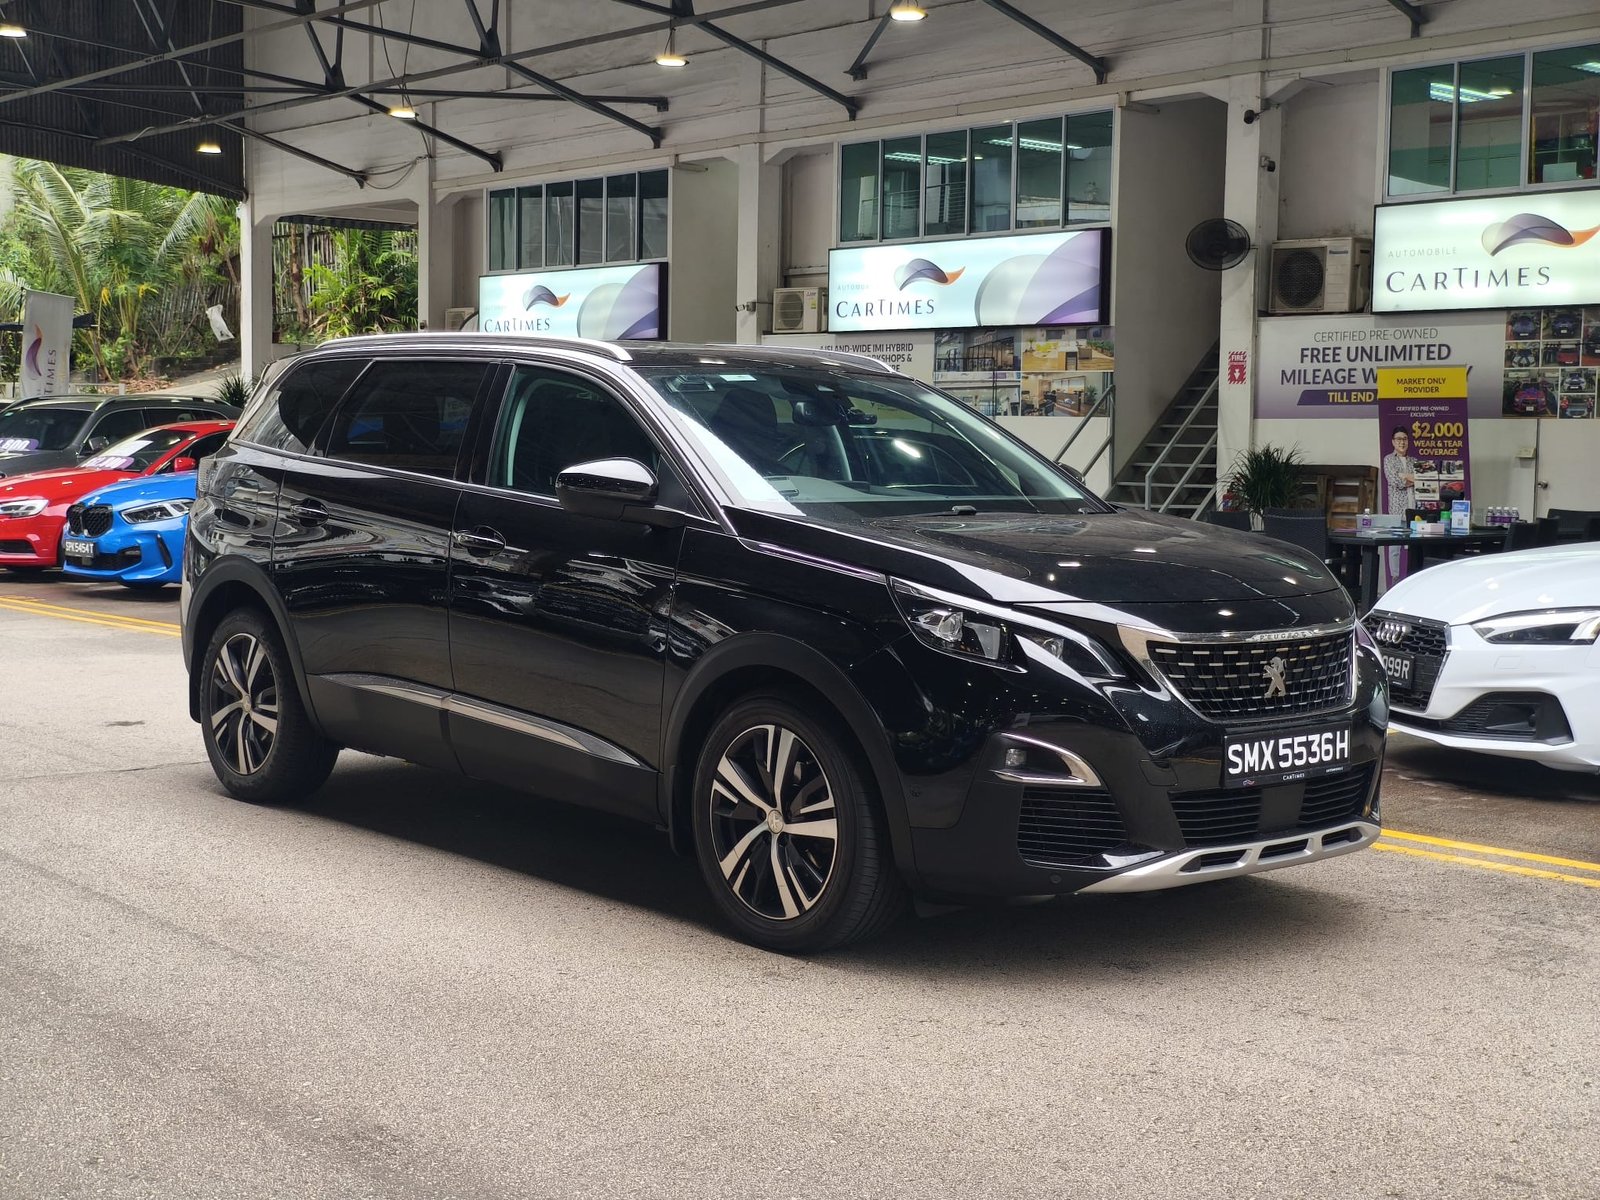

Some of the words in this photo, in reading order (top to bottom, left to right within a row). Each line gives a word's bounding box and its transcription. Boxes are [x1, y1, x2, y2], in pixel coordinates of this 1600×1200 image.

[1388, 247, 1457, 258] AUTOMOBILE
[1314, 330, 1367, 343] CERTIFIED
[1369, 328, 1438, 341] PRE-OWNED
[886, 343, 914, 351] HYBRID
[1300, 346, 1342, 363] FREE
[1346, 343, 1452, 362] UNLIMITED
[906, 353, 912, 362] &
[1281, 368, 1357, 385] MILEAGE
[1328, 391, 1350, 403] TILL
[1351, 391, 1374, 403] END
[1411, 421, 1464, 439] $2,000
[1418, 448, 1459, 456] COVERAGE
